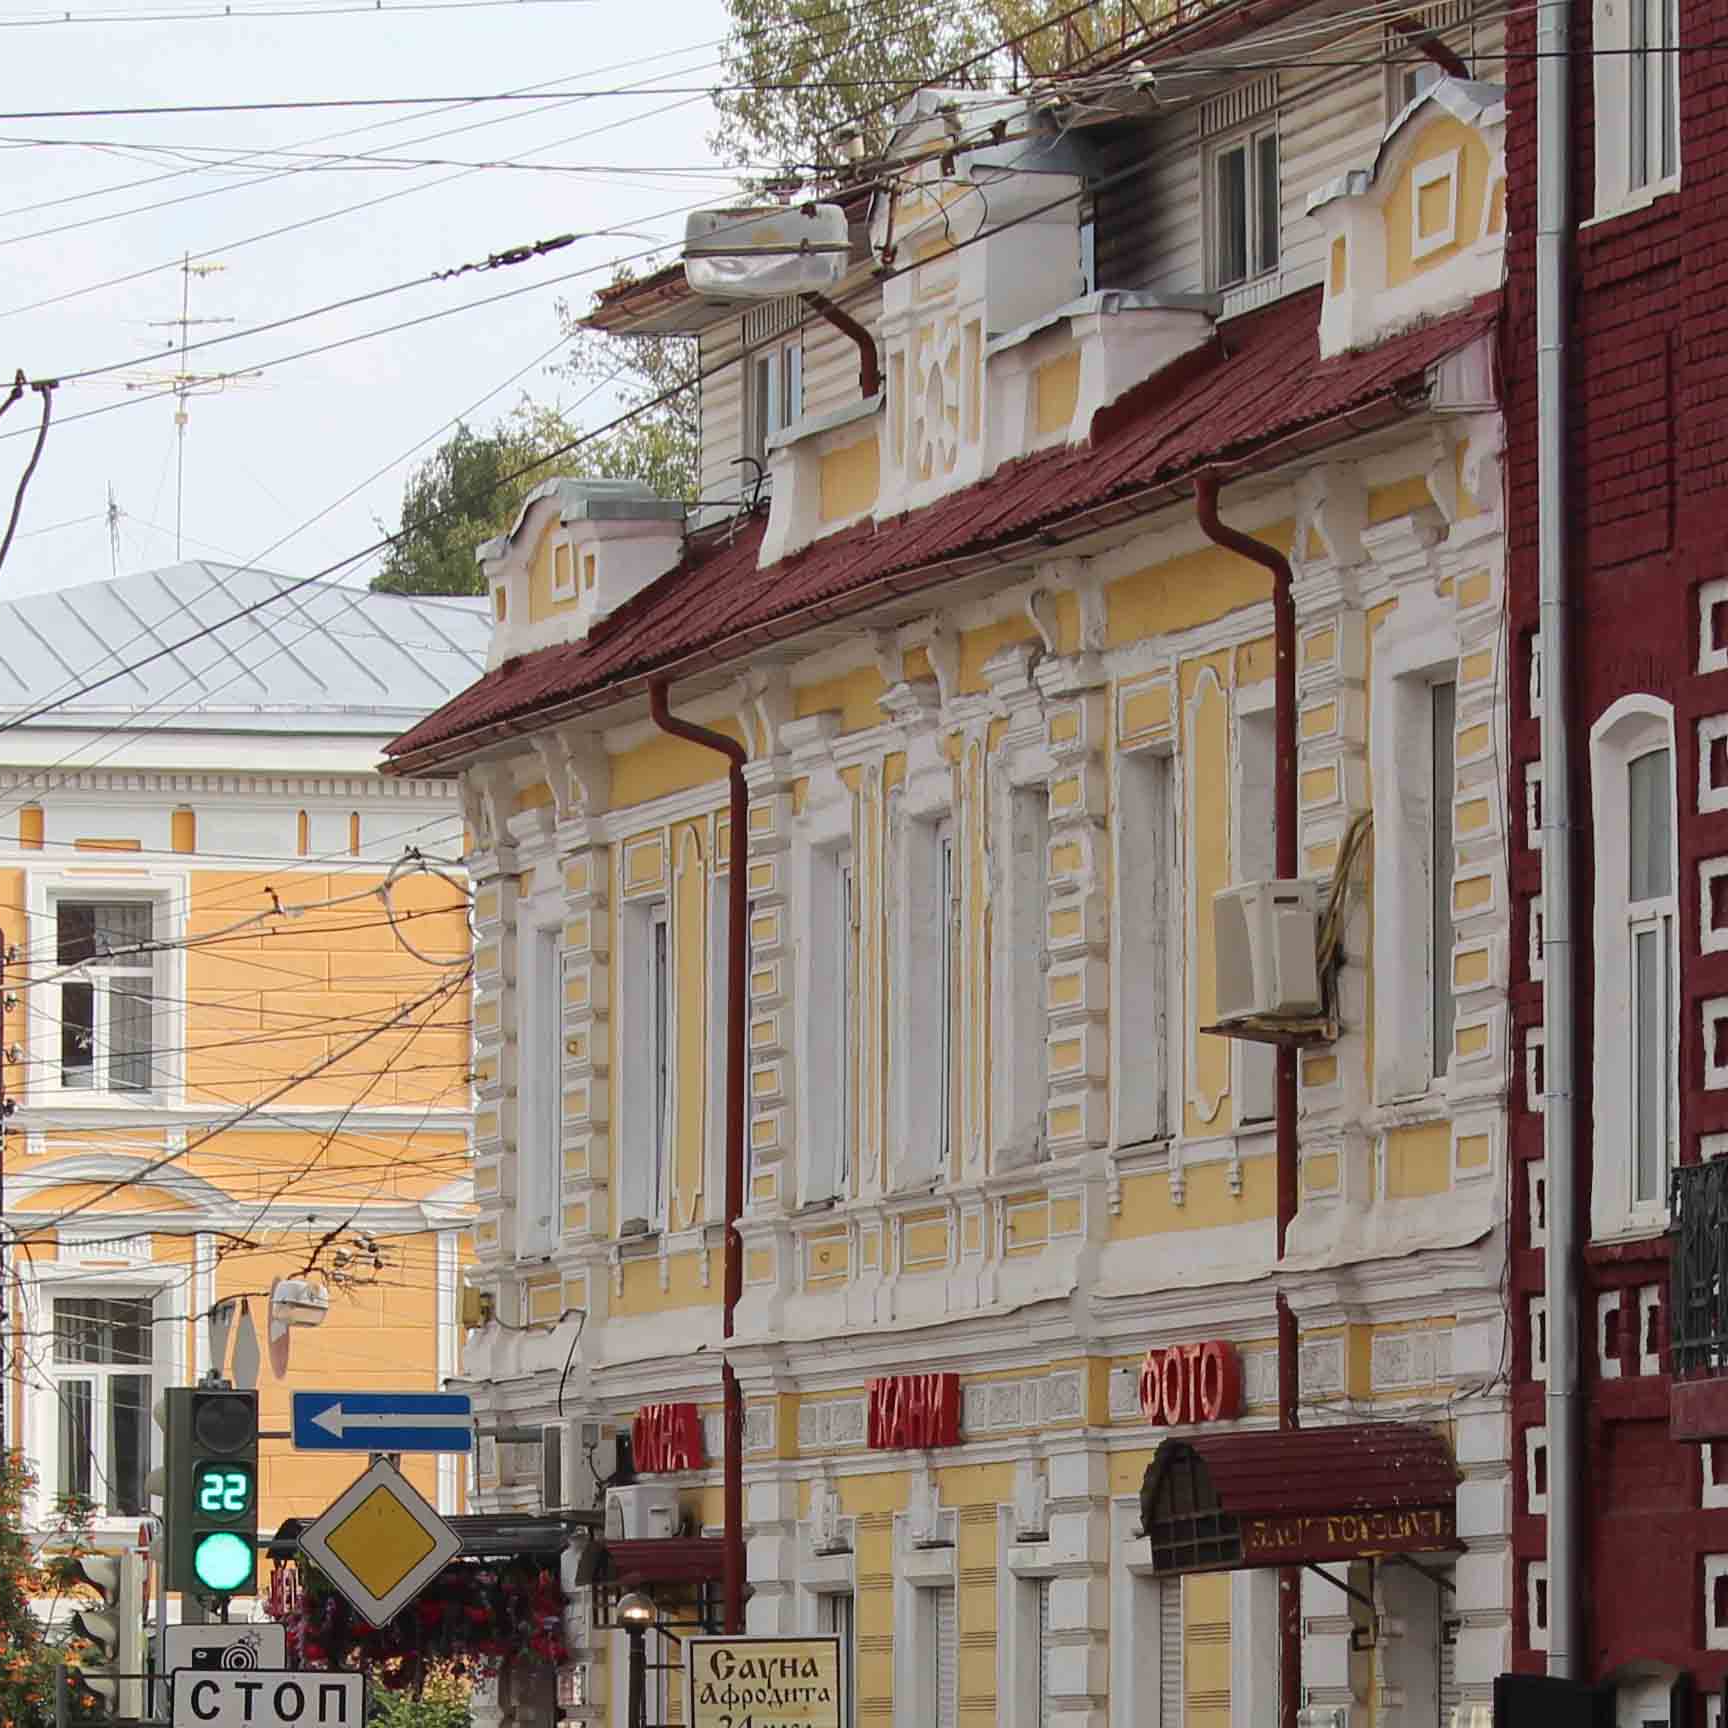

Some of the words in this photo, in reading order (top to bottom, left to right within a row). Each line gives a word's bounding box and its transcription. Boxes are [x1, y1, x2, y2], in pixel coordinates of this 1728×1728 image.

[1141, 1341, 1230, 1425] ФОТО
[866, 1373, 952, 1447] ТКАНИ
[201, 1474, 246, 1511] 22
[710, 1649, 819, 1689] Сауна
[190, 1679, 347, 1722] СТОП
[699, 1682, 831, 1711] Афродита
